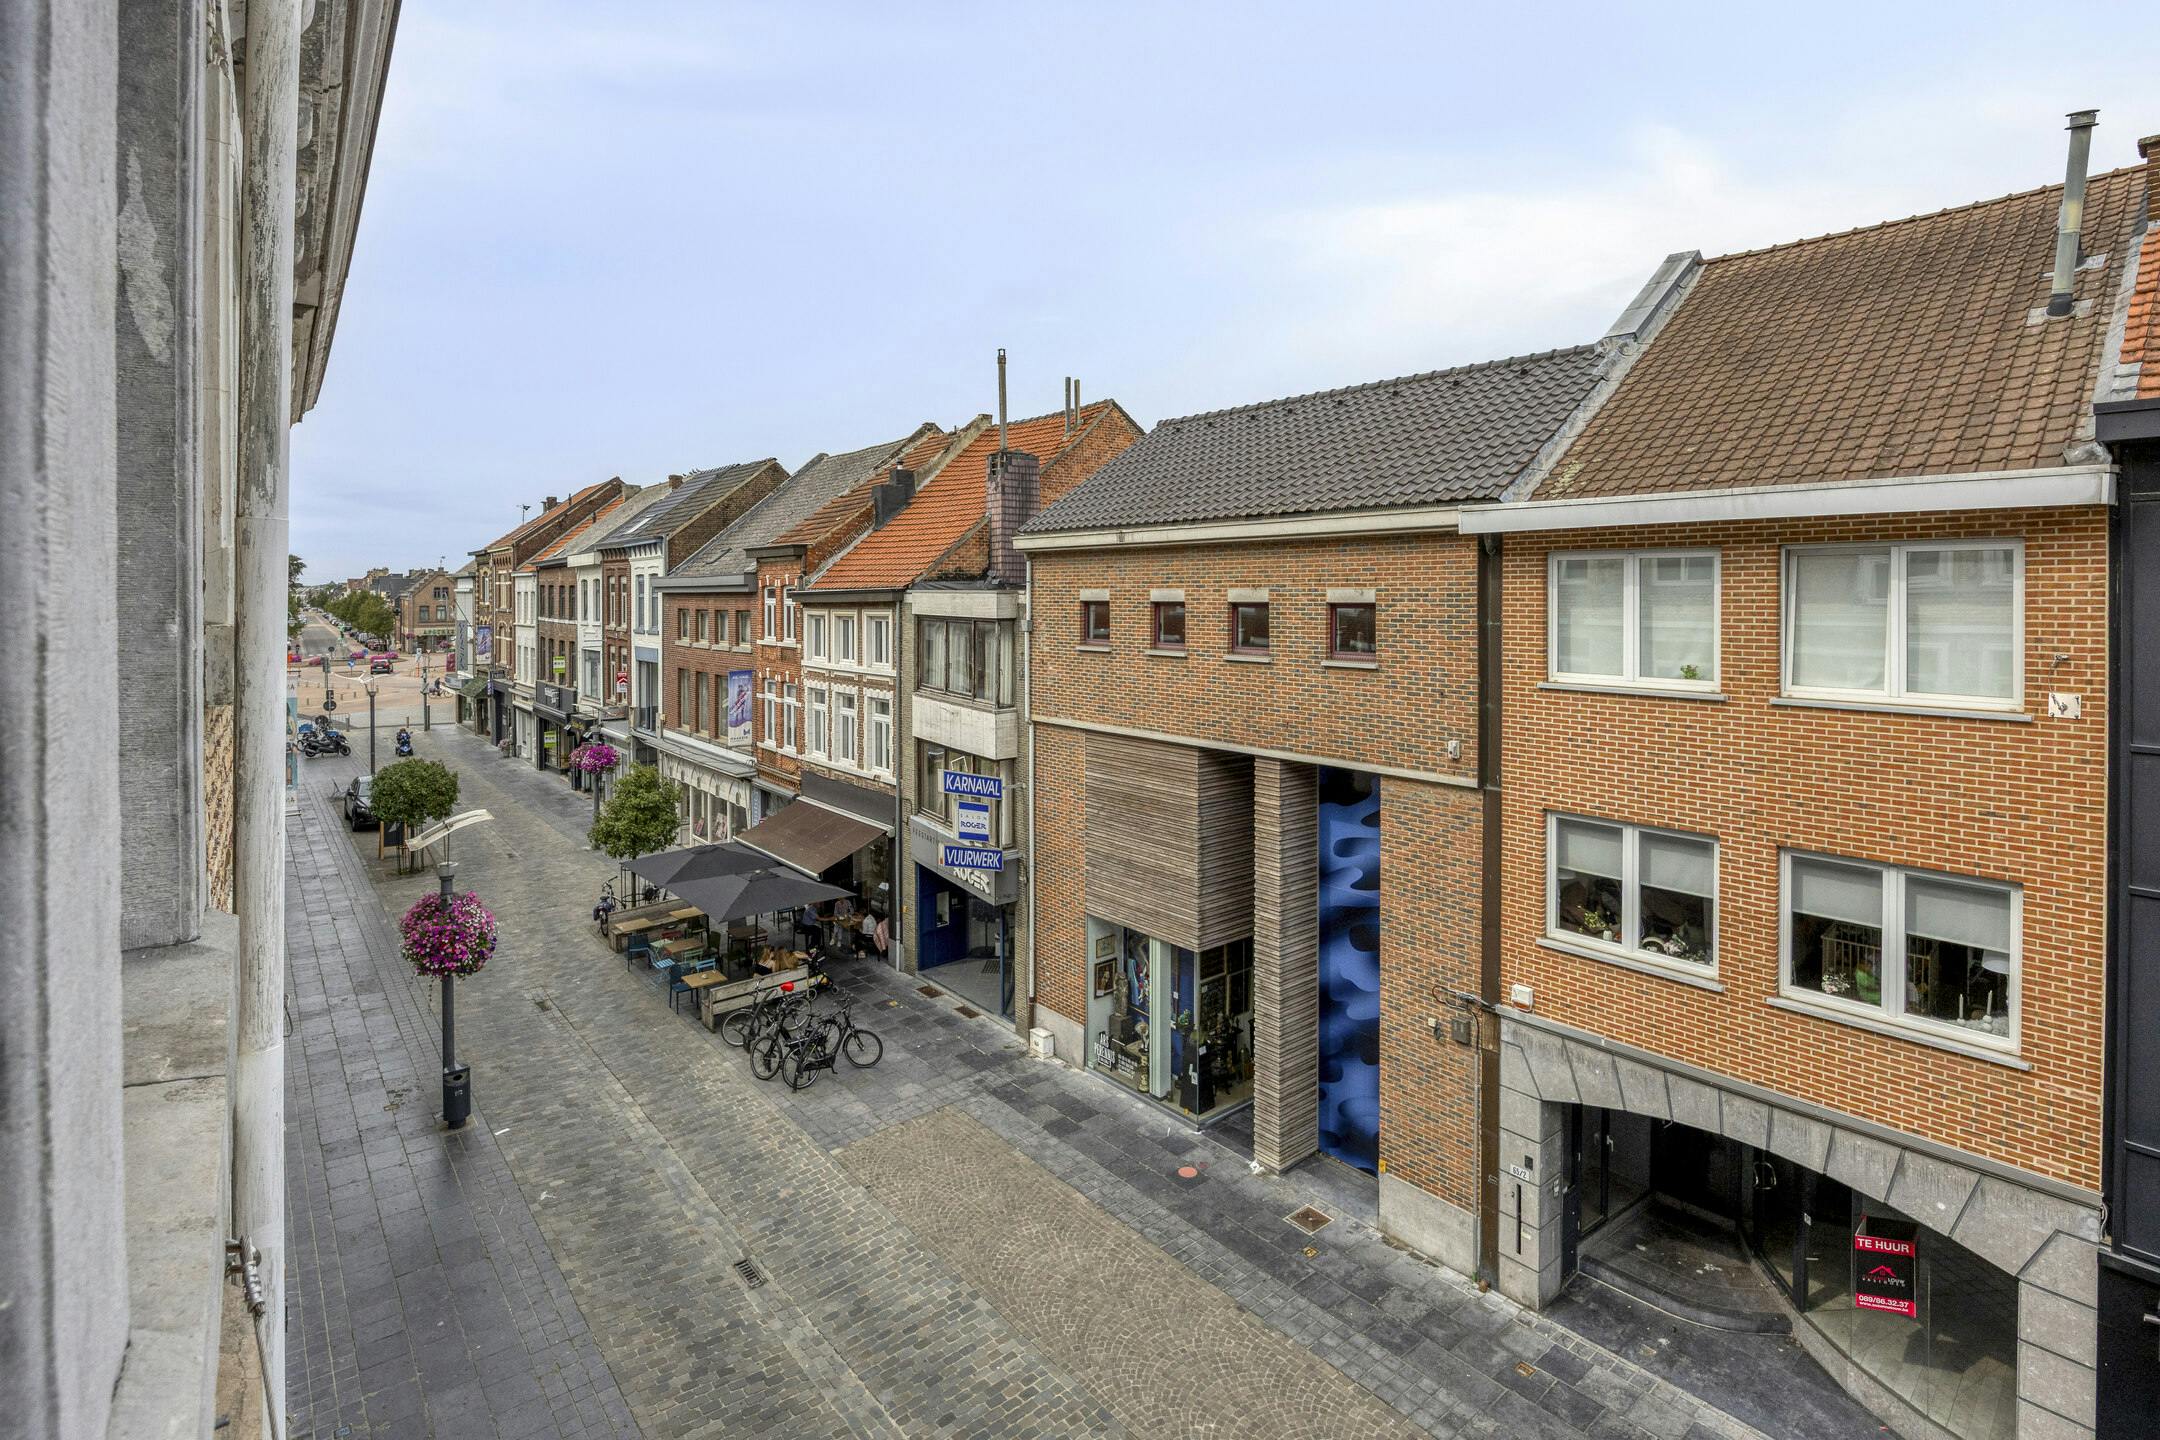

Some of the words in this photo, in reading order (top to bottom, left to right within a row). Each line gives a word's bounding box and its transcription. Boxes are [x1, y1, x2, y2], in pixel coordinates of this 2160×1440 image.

[946, 774, 1000, 795] KARNAVAL
[960, 820, 987, 830] ROGER
[946, 848, 1001, 868] VUURWERK
[1857, 1238, 1873, 1248] TE
[1875, 1240, 1910, 1253] HUUR
